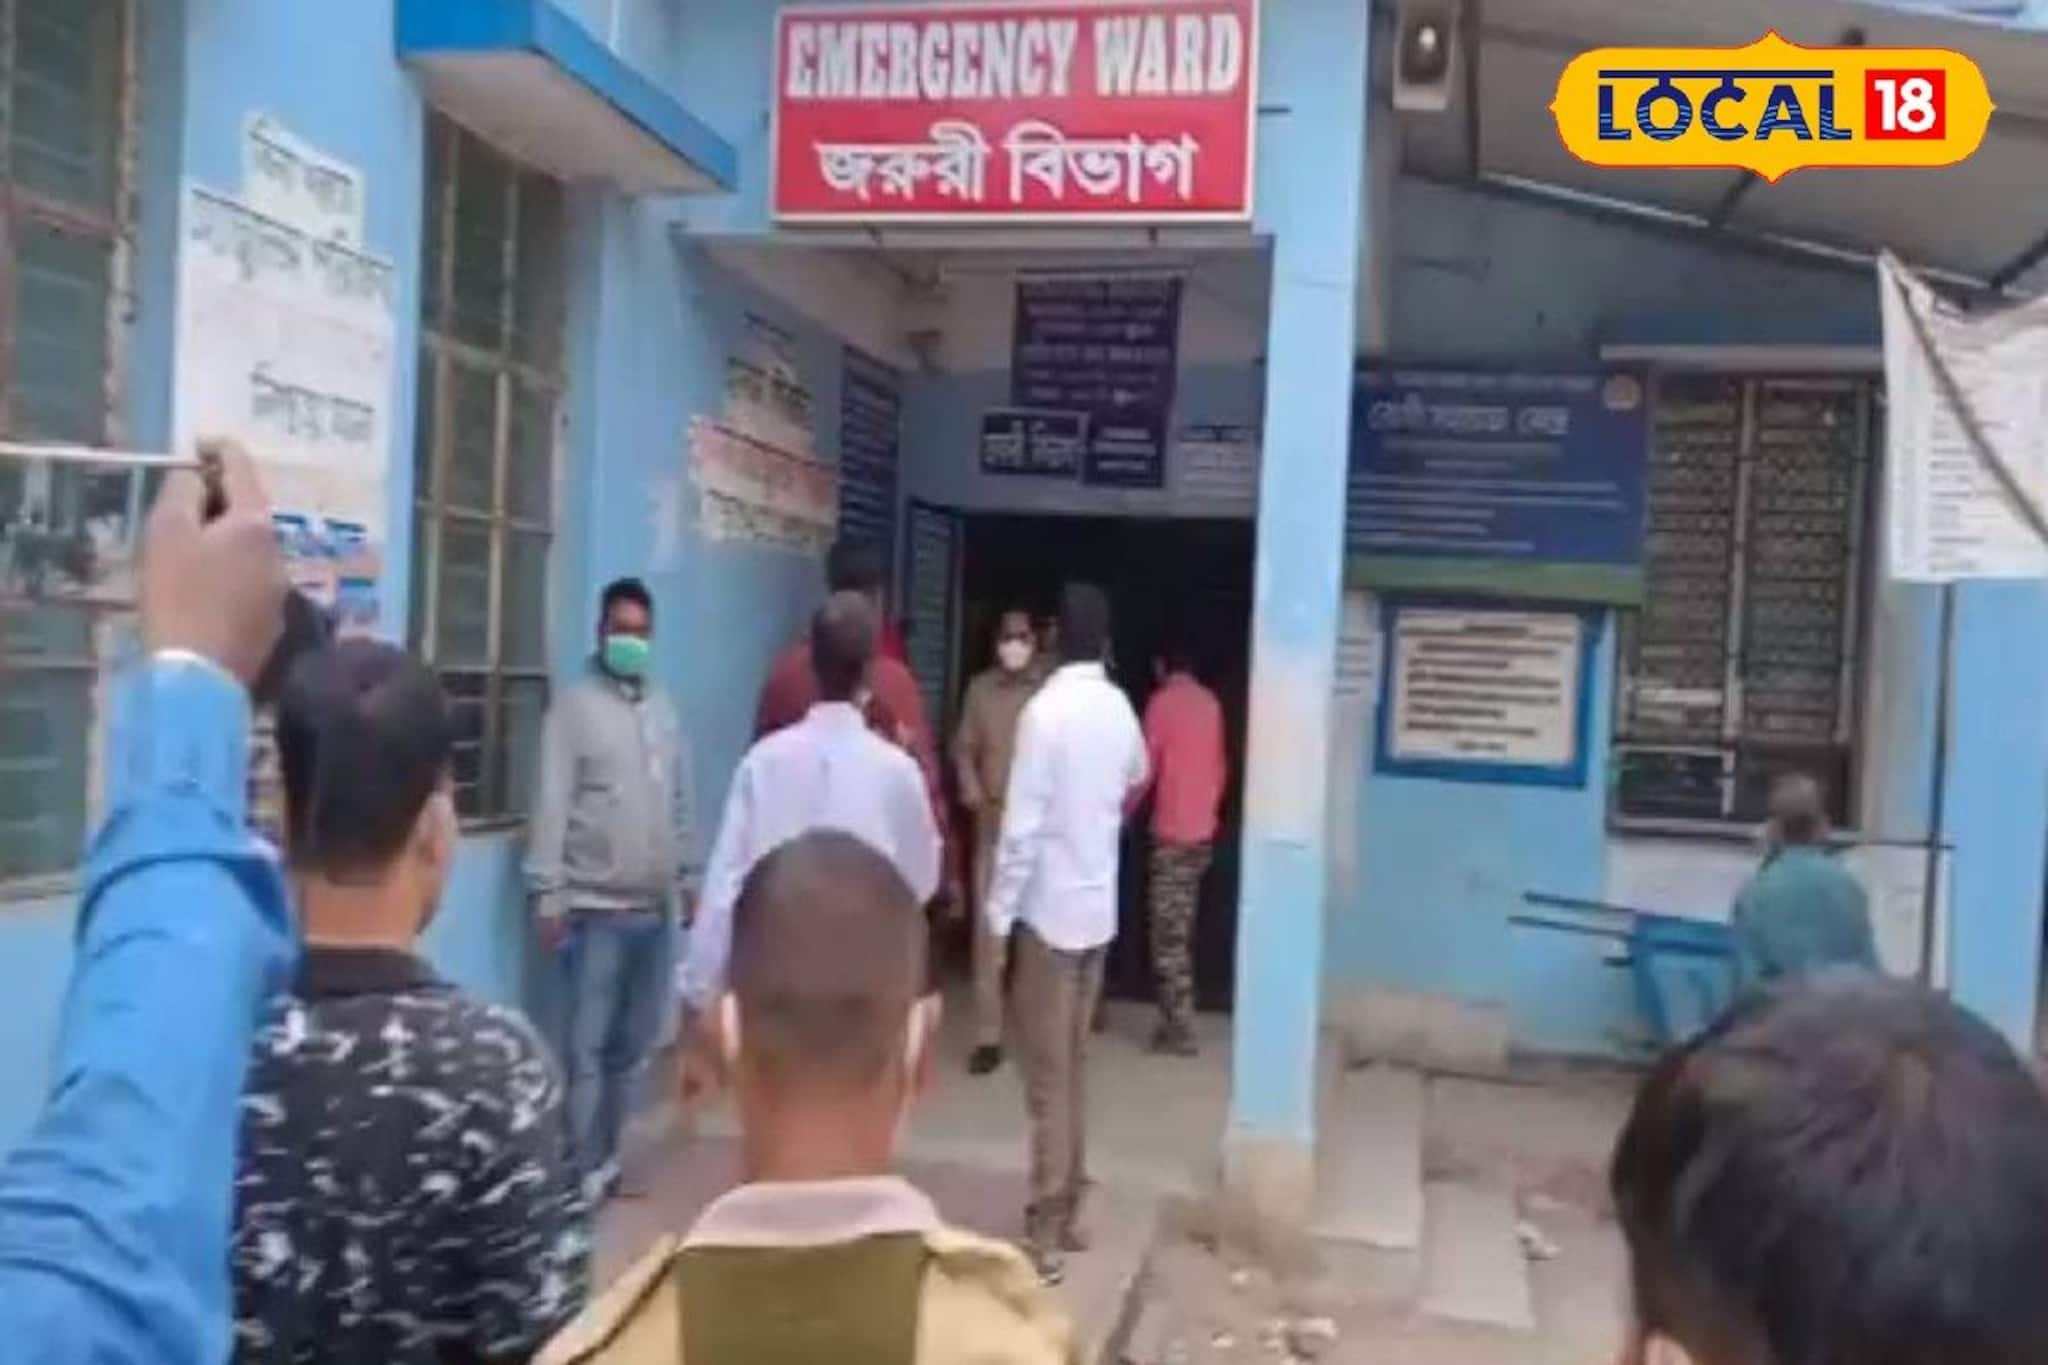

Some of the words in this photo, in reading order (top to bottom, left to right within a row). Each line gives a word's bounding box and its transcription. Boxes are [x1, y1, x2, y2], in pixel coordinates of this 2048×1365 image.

[787, 21, 1078, 98] EMERGENCY
[1094, 14, 1241, 95] WARD
[813, 121, 991, 202] জরুরী
[1002, 121, 1200, 203] বিভাগ
